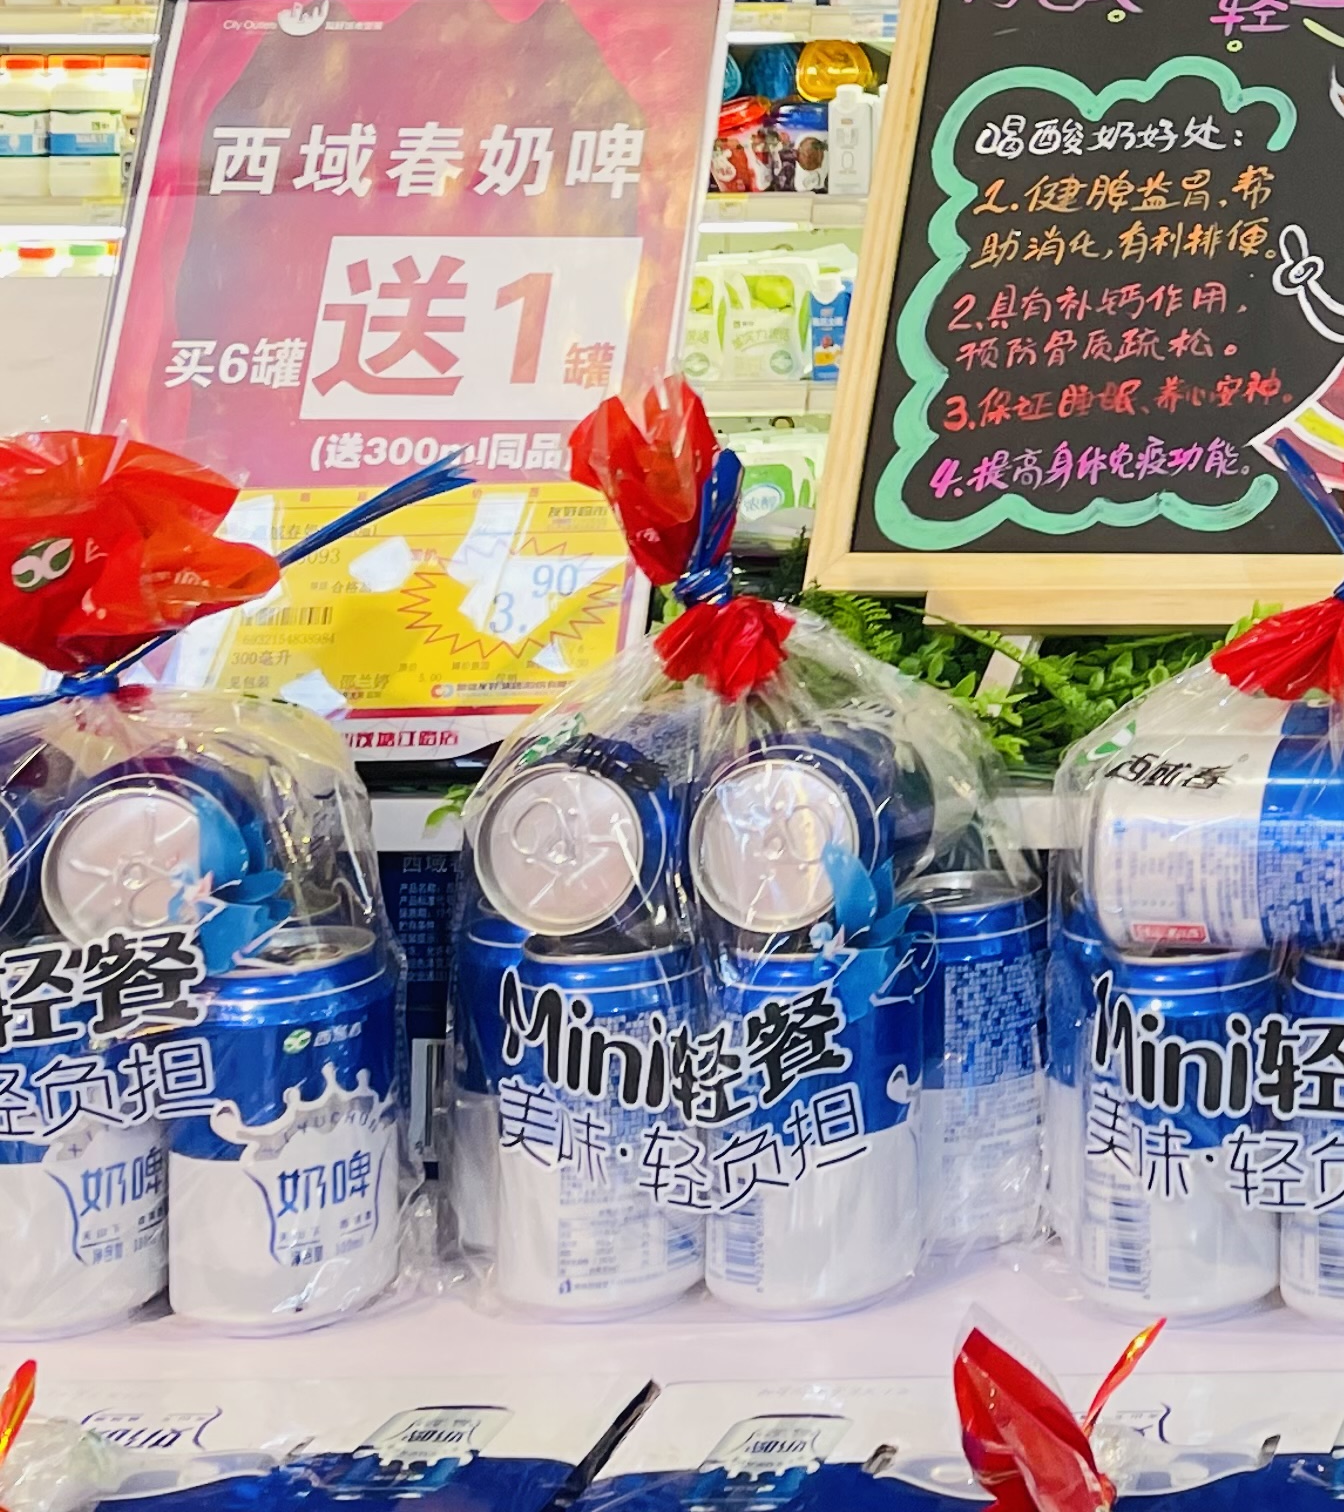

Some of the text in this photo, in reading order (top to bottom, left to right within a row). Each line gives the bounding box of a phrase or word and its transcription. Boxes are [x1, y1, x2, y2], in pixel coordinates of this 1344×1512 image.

[208, 122, 646, 199] 西域春奶啤
[163, 338, 308, 390] 买6罐
[311, 254, 556, 398] 送1
[531, 563, 580, 598] 90
[277, 1149, 373, 1219] 奶啤
